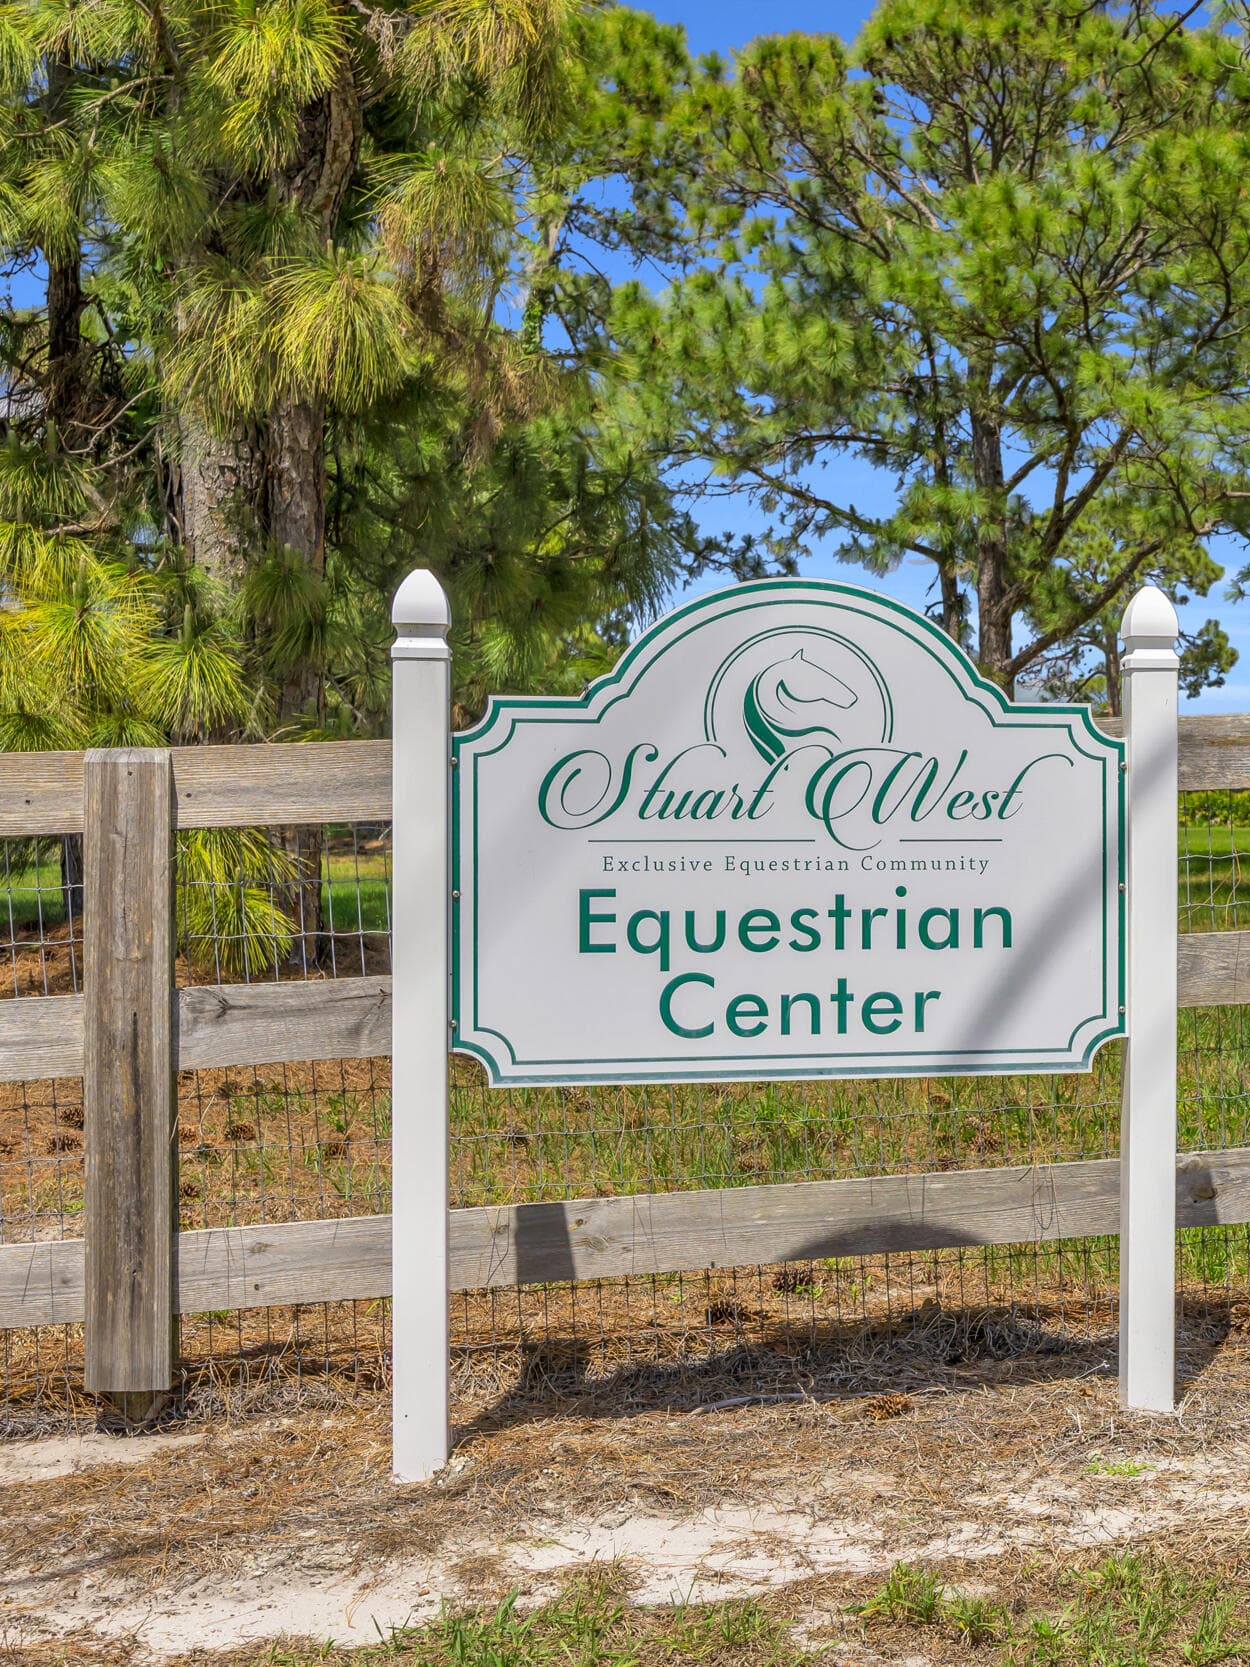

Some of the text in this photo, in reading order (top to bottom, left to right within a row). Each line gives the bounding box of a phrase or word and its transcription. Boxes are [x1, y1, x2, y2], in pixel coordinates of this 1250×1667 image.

[537, 743, 1075, 851] Stuart West
[602, 855, 990, 876] Exclusive Equestrian Community
[578, 886, 1013, 972] Equestrian
[658, 972, 942, 1040] Center
